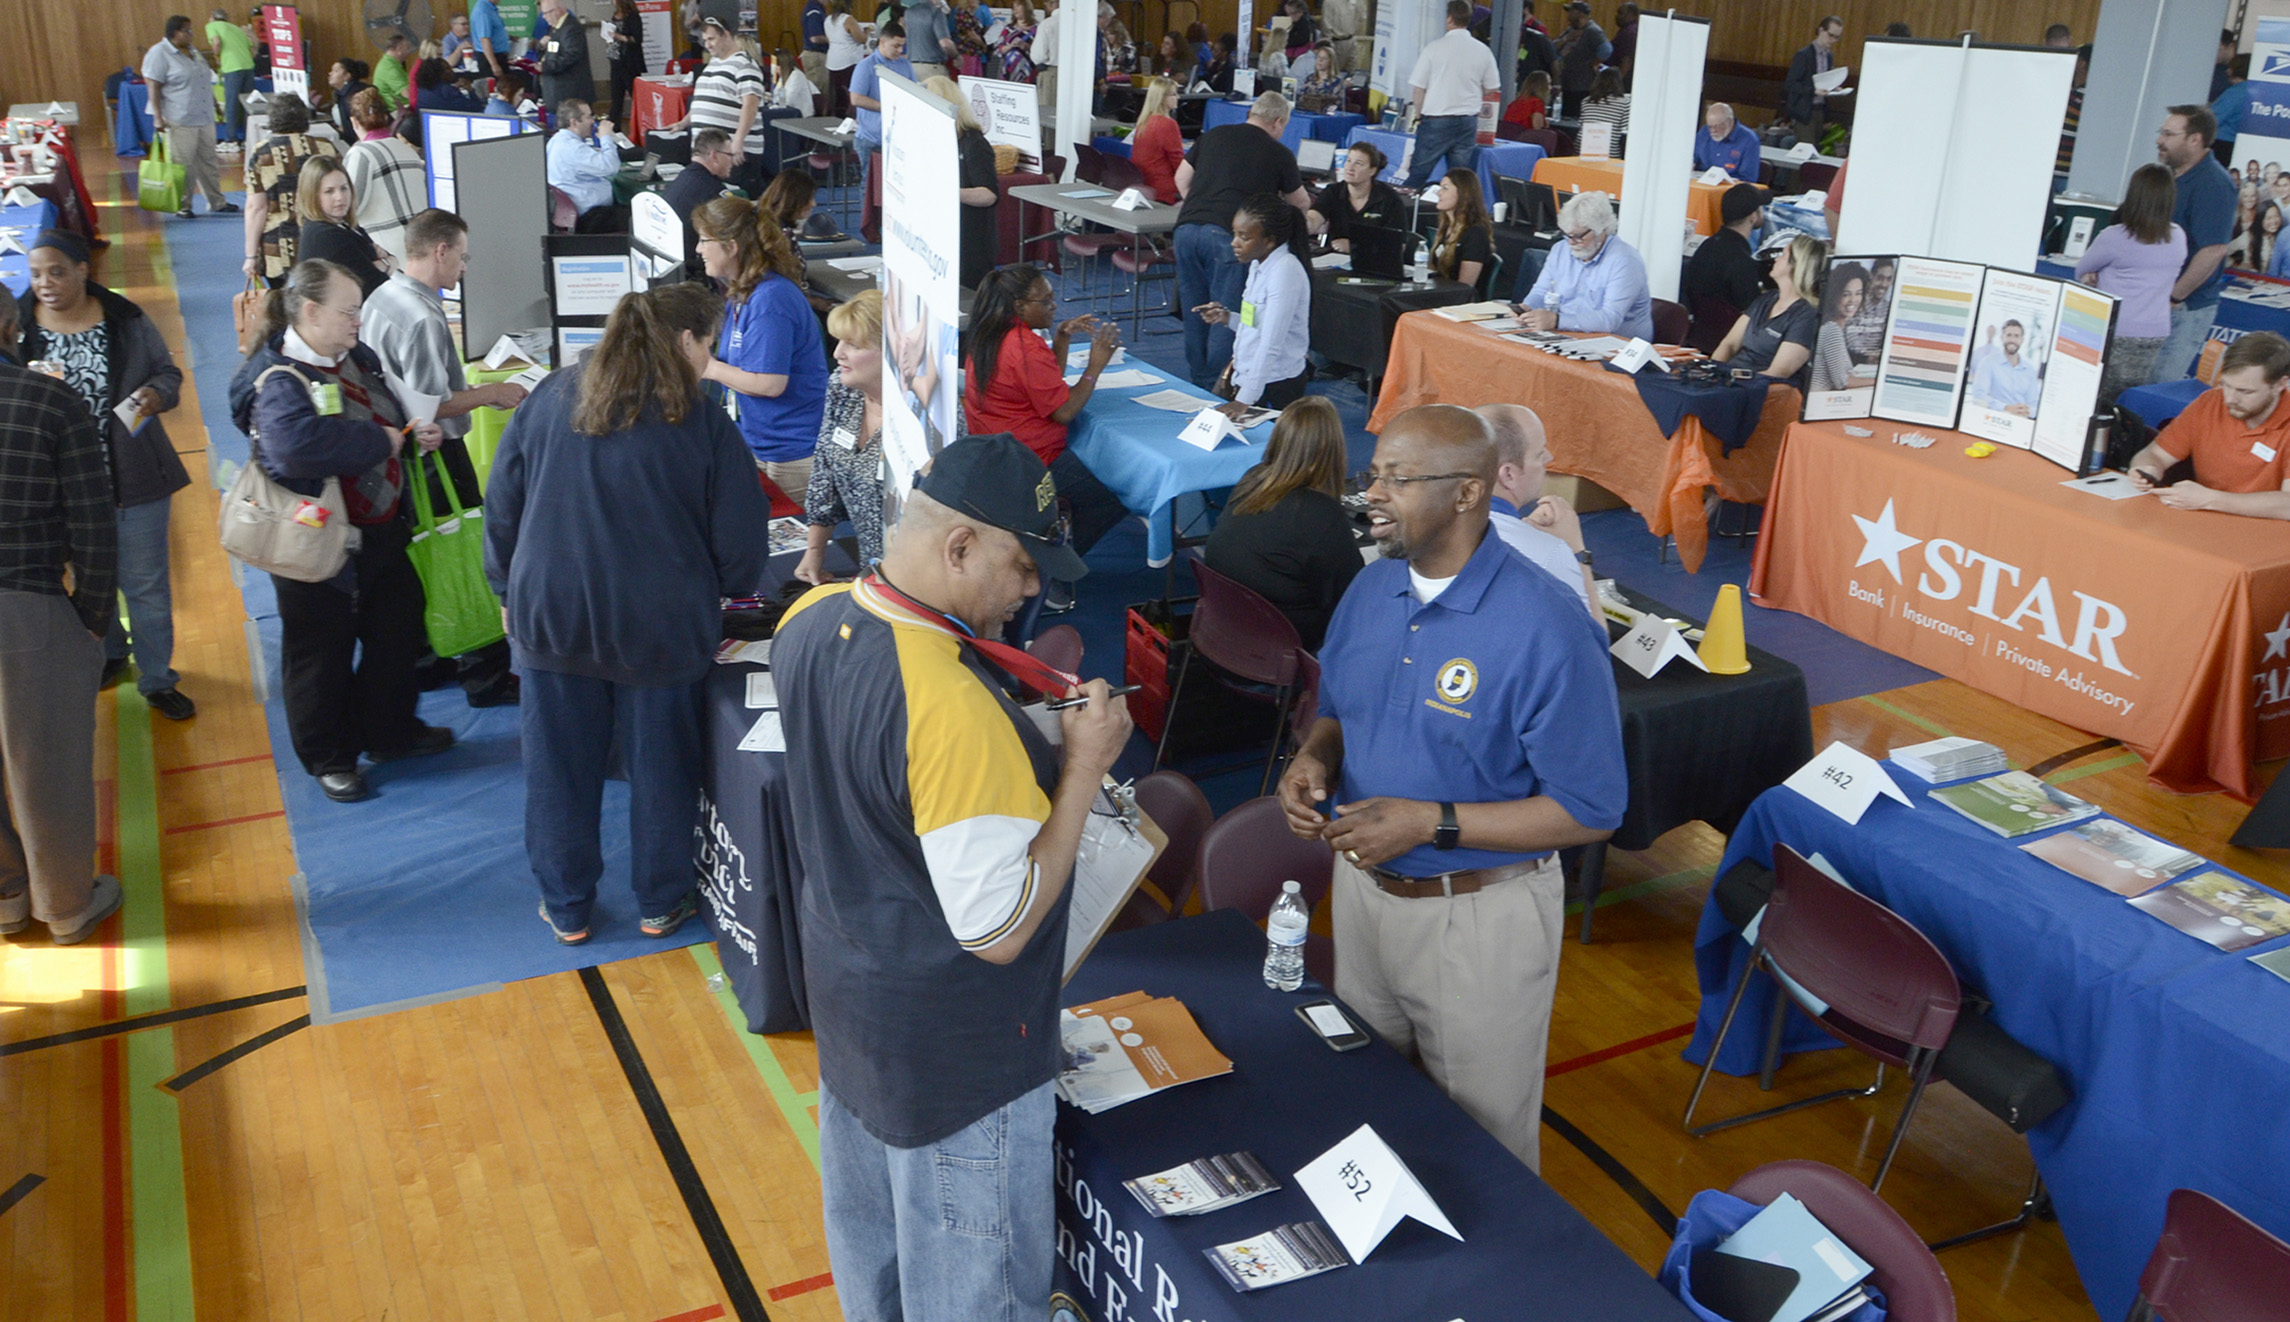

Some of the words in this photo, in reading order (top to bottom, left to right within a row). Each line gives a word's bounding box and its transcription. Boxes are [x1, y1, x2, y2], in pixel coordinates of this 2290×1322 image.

[990, 92, 1016, 109] Staffing
[2251, 101, 2272, 116] The
[996, 109, 1030, 126] Resources
[1917, 538, 2134, 677] STAR
[1635, 632, 1658, 652] #43
[1848, 579, 1885, 609] Bank
[1902, 601, 1976, 647] Insurance
[1996, 639, 2052, 679] Private
[2054, 667, 2135, 716] Advisory
[1424, 698, 1472, 719] INDIANAPOLIS
[1821, 764, 1854, 791] #42
[1338, 1159, 1373, 1203] #52
